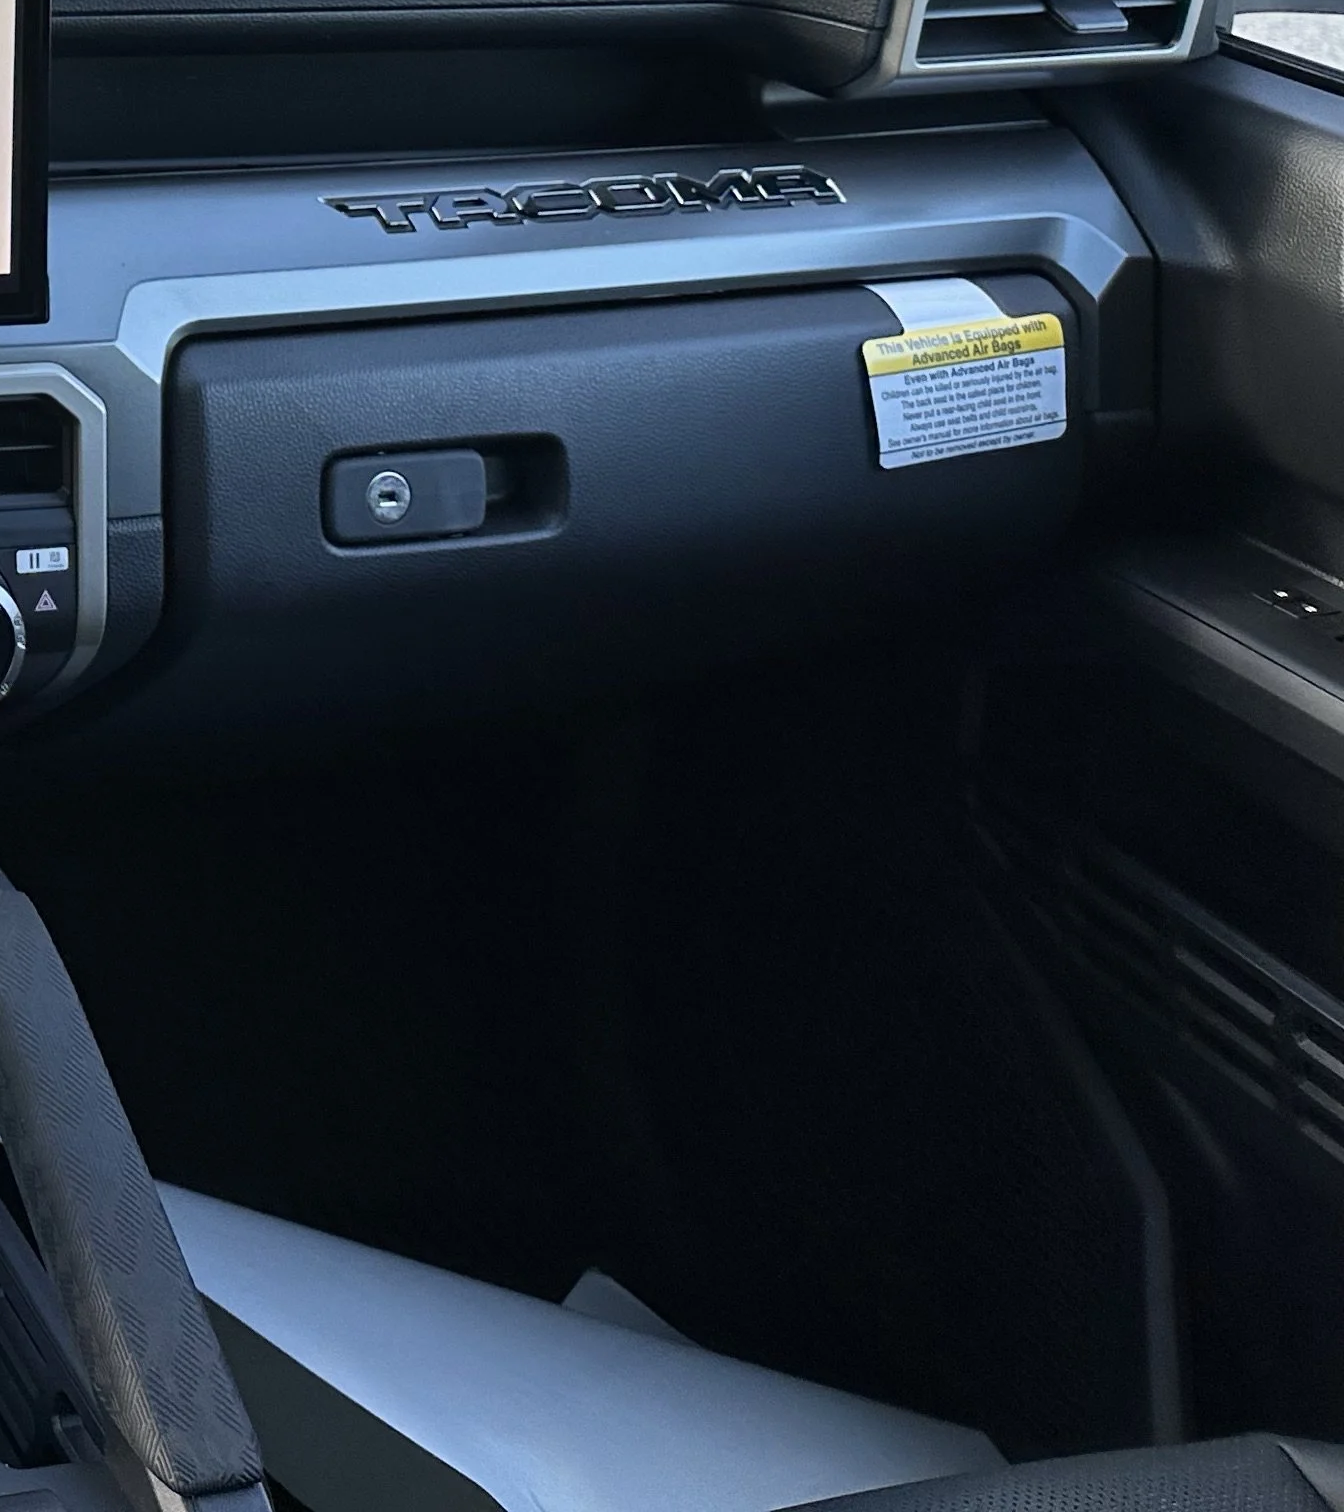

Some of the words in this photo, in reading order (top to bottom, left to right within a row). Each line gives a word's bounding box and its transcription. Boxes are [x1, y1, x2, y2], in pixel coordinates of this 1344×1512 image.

[317, 164, 848, 235] TACOMA
[876, 342, 904, 356] This
[907, 333, 949, 351] Vehicle
[963, 322, 1020, 343] Equipped
[1022, 319, 1047, 334] with
[911, 345, 969, 366] Advanced
[971, 342, 989, 357] Air
[992, 337, 1021, 354] Bags
[904, 372, 927, 385] Even
[929, 368, 948, 381] with
[950, 361, 994, 377] Advanced
[996, 359, 1010, 370] Air
[1012, 355, 1035, 368] Bags
